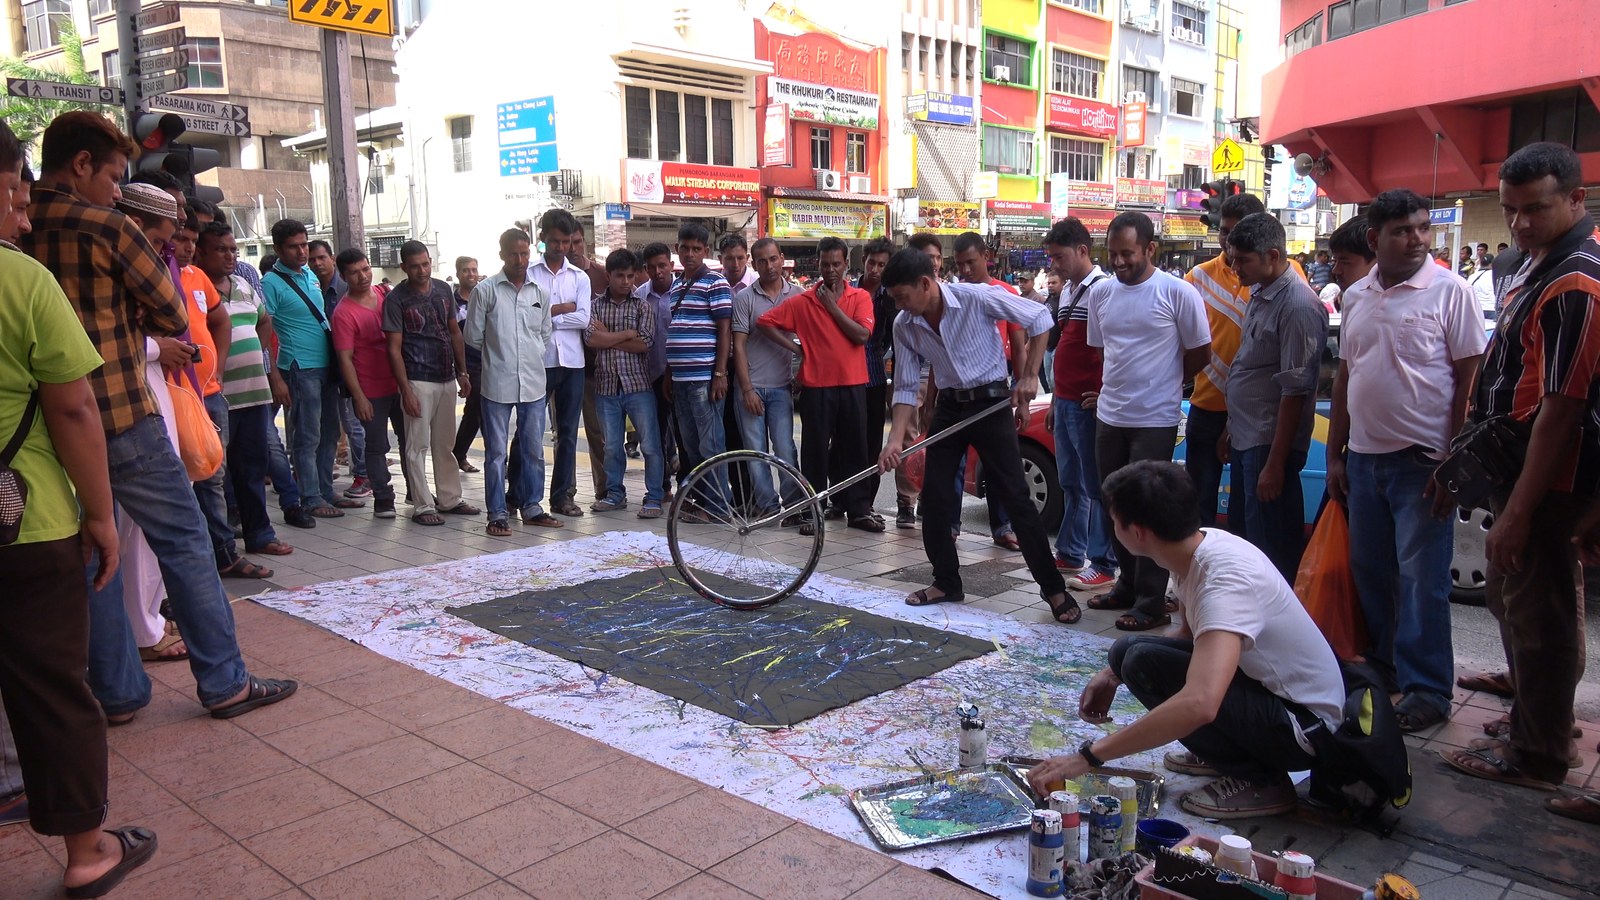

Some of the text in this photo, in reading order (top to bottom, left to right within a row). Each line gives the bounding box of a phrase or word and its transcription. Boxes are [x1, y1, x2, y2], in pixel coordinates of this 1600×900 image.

[52, 86, 92, 99] TRANSIT
[776, 82, 878, 108] THE KHUKURI RESTAURANT
[929, 92, 952, 103] BUTIK
[155, 96, 216, 114] PASARAMA KOTA
[193, 119, 219, 131] STREET
[665, 176, 760, 192] MALIK STREAMS CORPORATION
[775, 202, 810, 212] PEMBORONG
[811, 204, 823, 212] DAN
[792, 214, 813, 223] KABIR
[814, 215, 830, 227] MAJU
[831, 216, 846, 227] JAYA
[1435, 211, 1441, 219] AH
